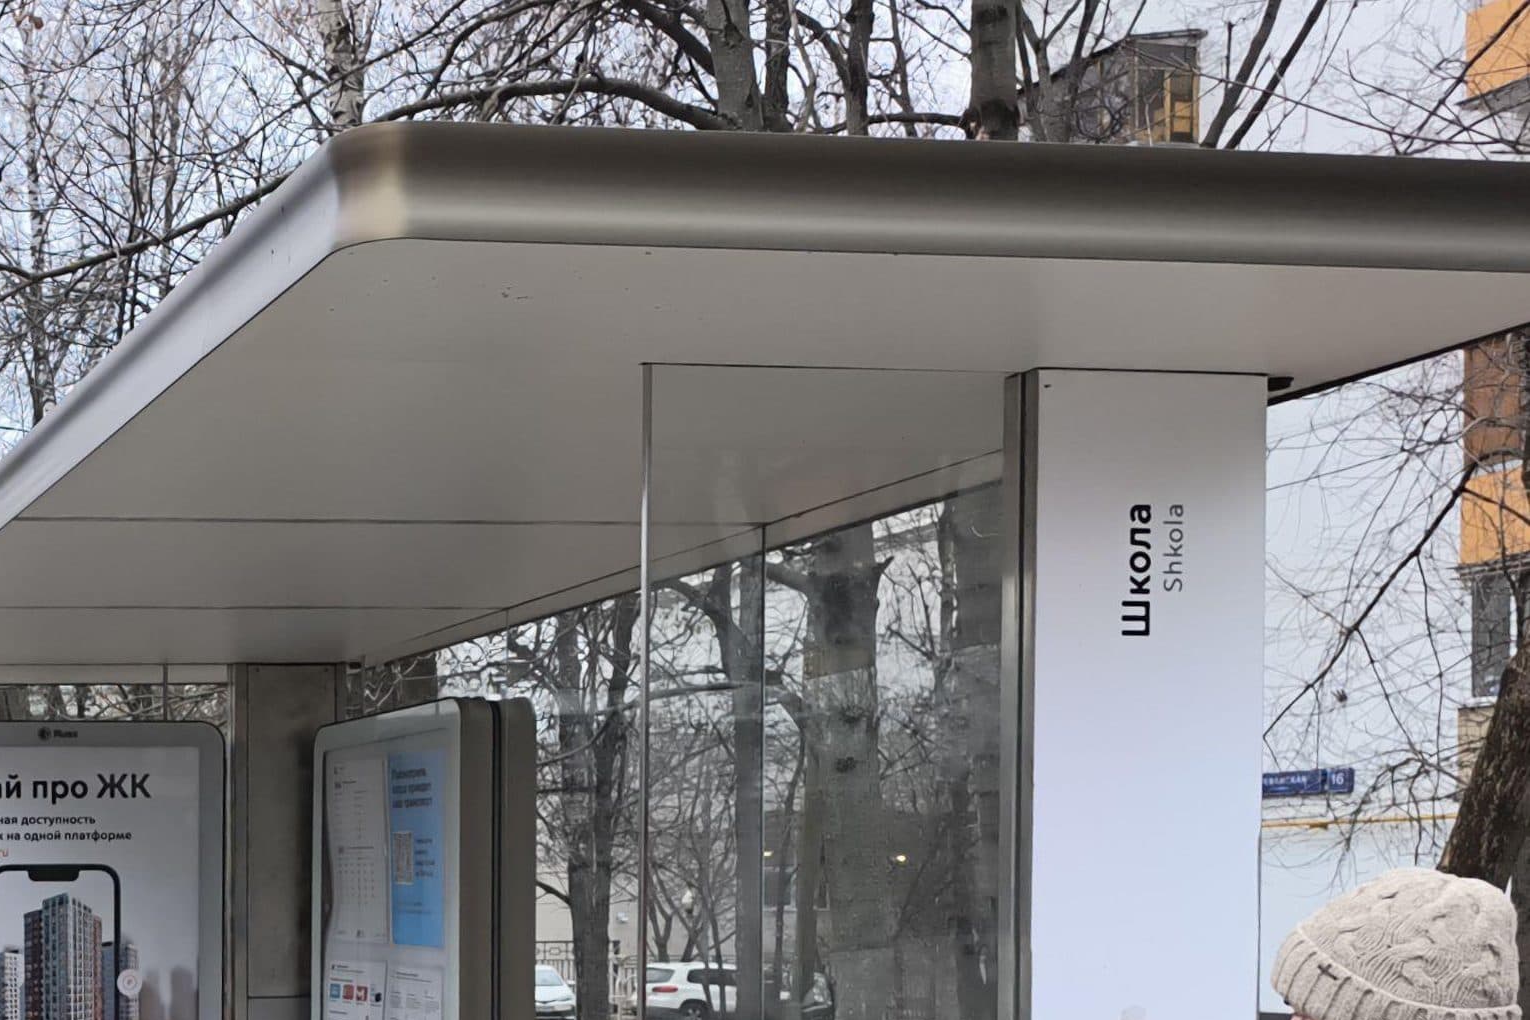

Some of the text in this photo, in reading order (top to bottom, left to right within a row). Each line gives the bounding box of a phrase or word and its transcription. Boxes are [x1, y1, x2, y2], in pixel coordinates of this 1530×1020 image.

[1163, 503, 1184, 592] Shkola
[1121, 503, 1152, 637] Школа
[32, 778, 88, 804] про
[97, 773, 152, 798] ЖК
[1331, 772, 1345, 785] 16
[21, 814, 96, 826] доступность
[6, 832, 20, 841] на
[24, 830, 61, 842] одной
[64, 830, 132, 844] платформе
